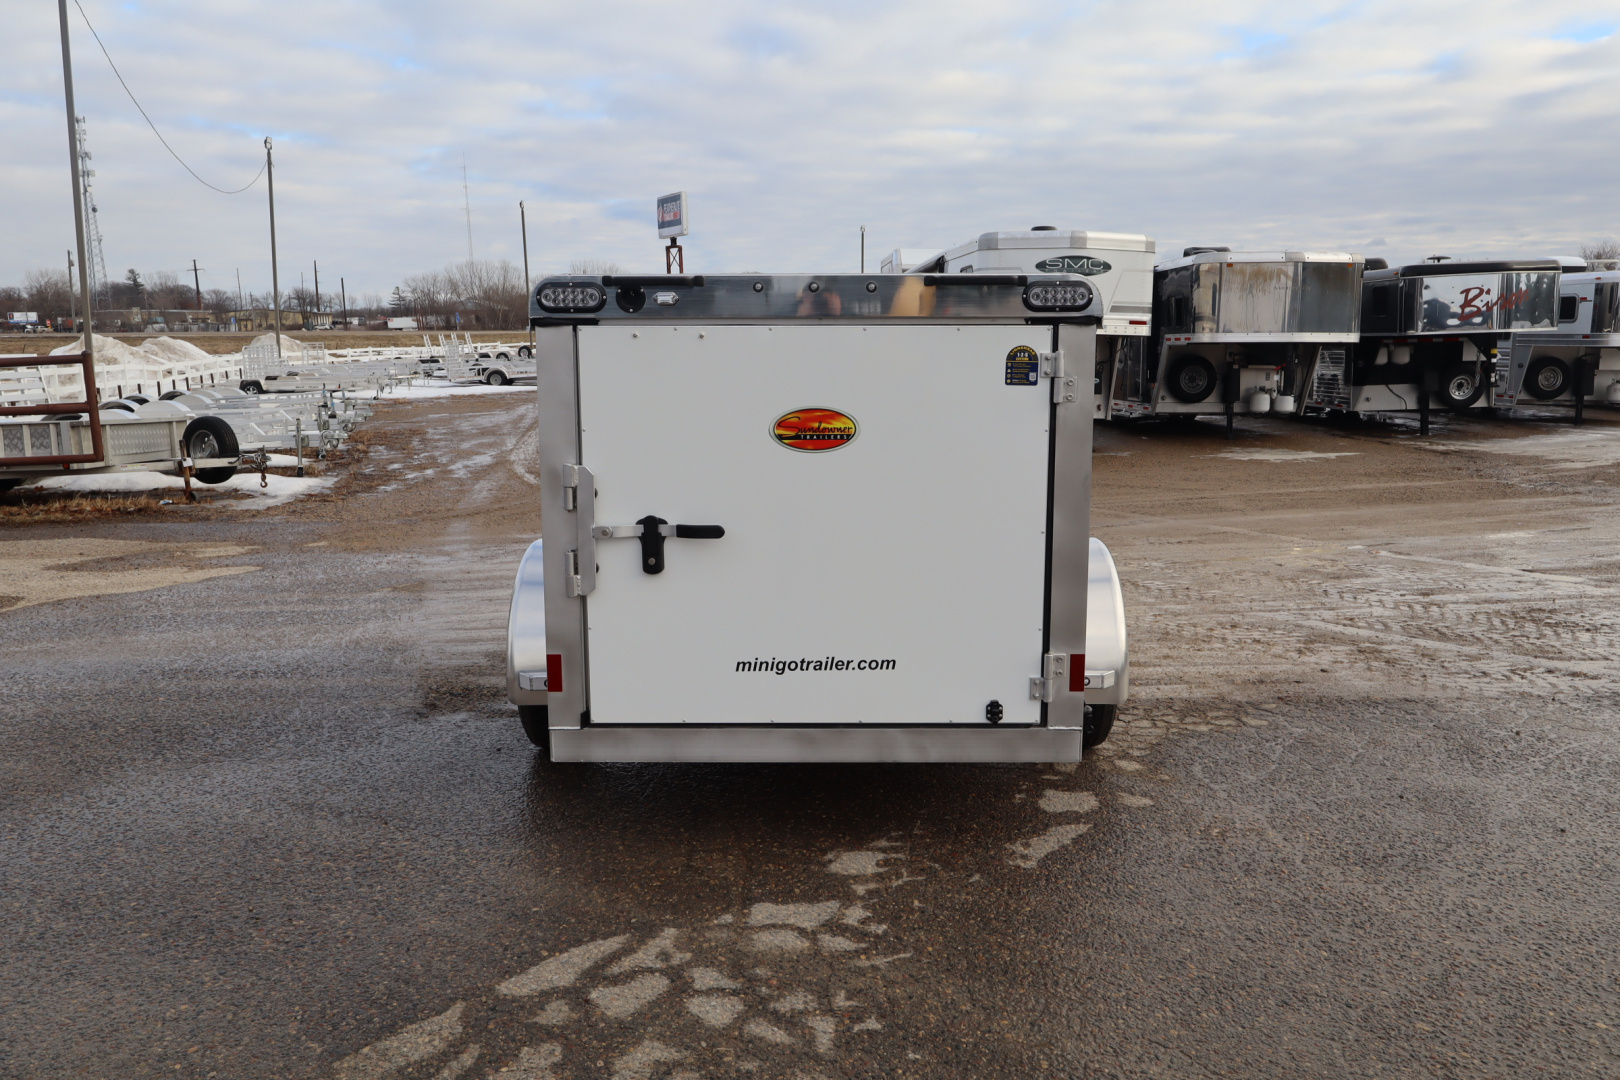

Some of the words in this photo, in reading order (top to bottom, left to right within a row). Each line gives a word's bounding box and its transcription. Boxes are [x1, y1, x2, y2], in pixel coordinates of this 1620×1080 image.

[1045, 258, 1104, 270] SMC
[1458, 286, 1530, 322] Bison
[778, 416, 853, 438] Sundowner
[735, 656, 897, 676] minigotrailer.com
